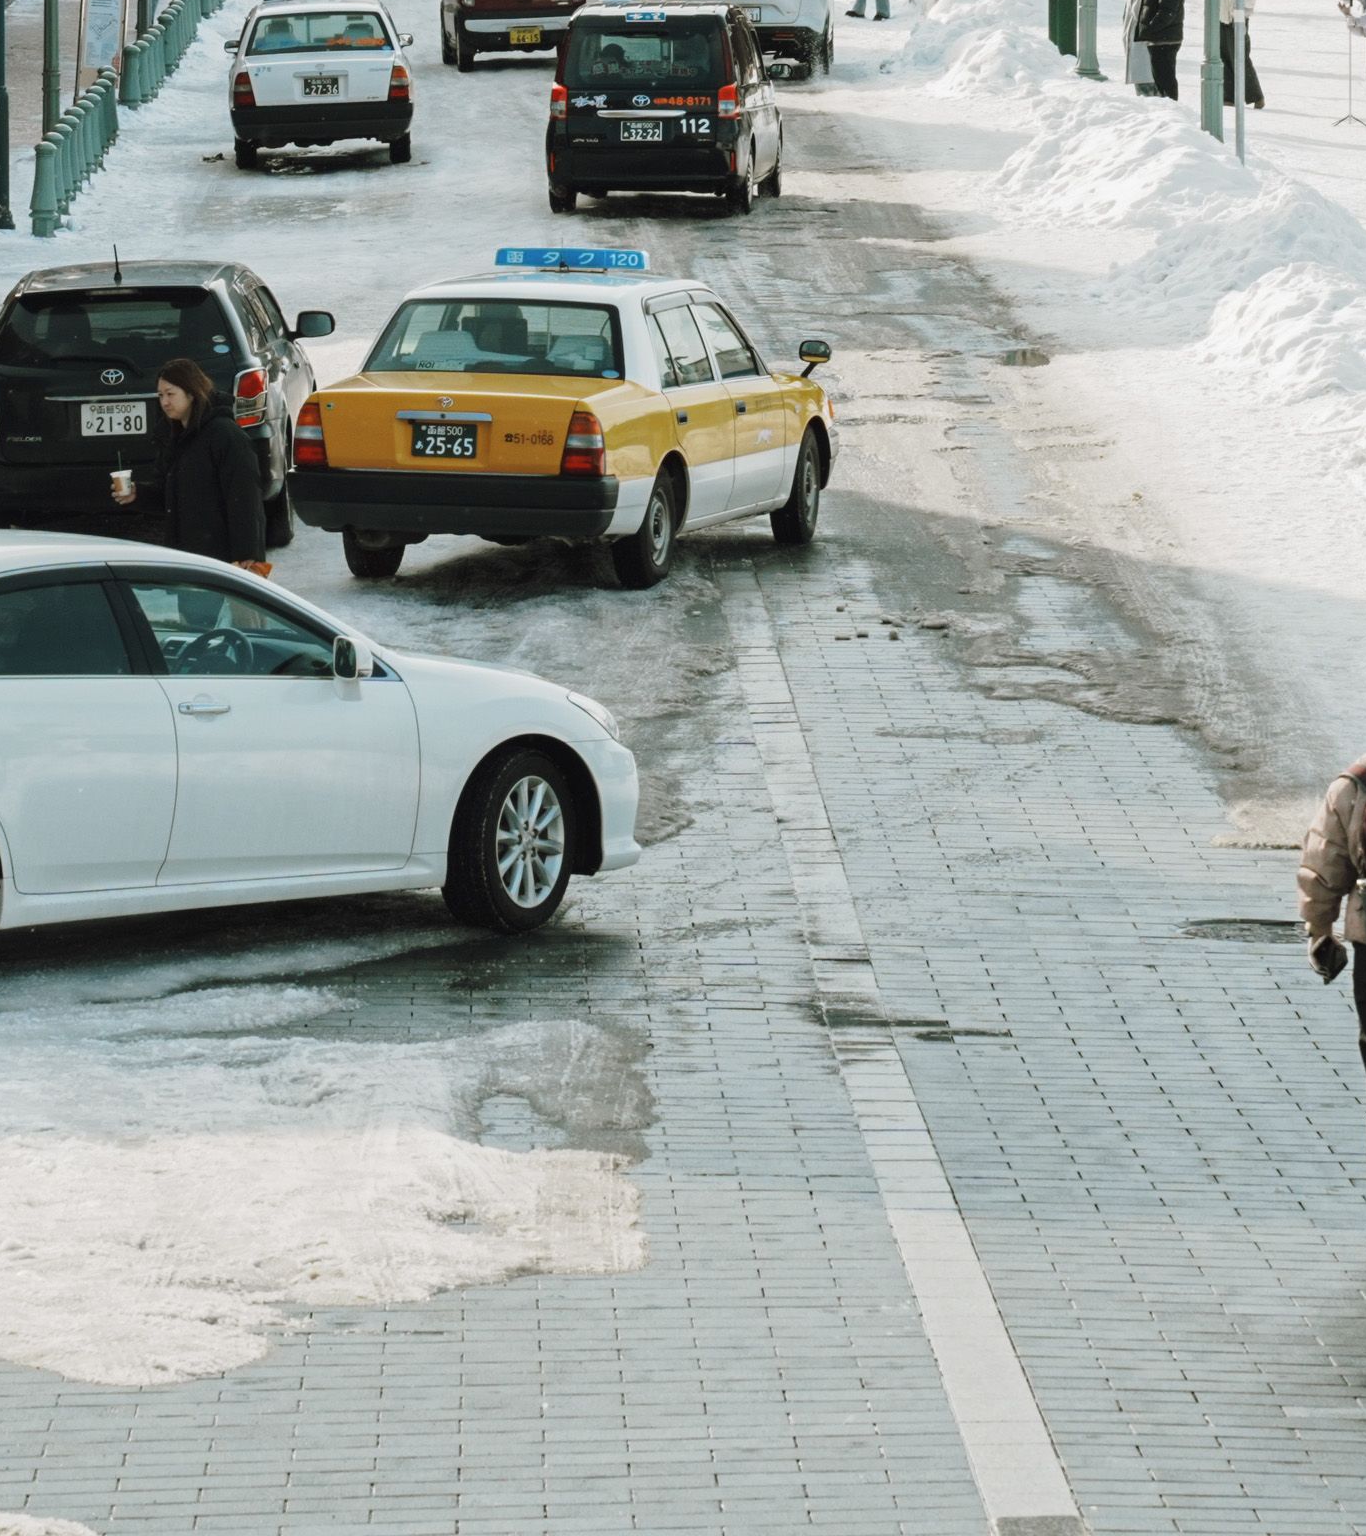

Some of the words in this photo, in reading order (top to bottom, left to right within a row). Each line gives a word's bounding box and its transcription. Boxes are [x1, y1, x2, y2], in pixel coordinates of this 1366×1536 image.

[310, 86, 338, 96] 27-36
[680, 119, 710, 134] 112
[629, 128, 661, 141] 32-22
[609, 253, 639, 266] 120
[96, 415, 143, 433] 21-80
[425, 437, 474, 456] 25-65
